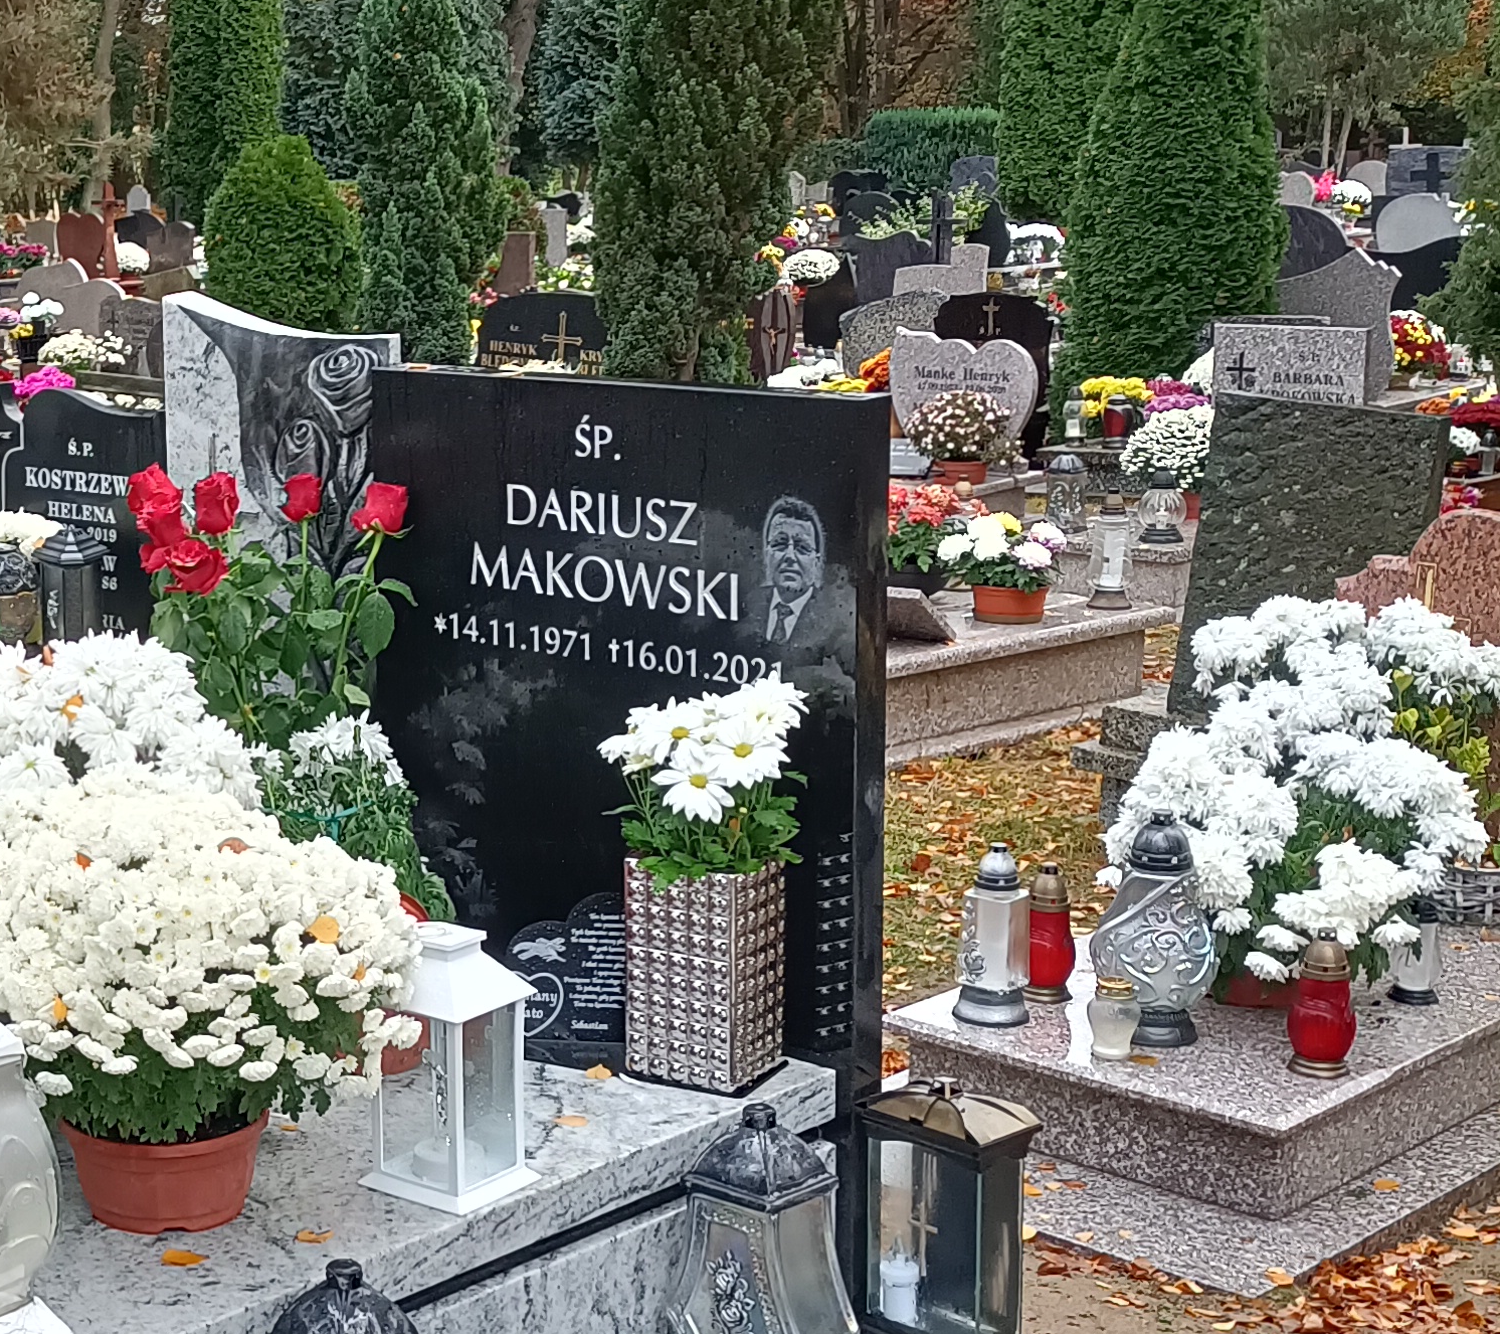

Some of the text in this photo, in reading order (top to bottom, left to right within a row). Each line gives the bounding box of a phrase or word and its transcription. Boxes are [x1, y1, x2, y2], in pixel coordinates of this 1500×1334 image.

[489, 340, 537, 356] HENRYK
[963, 367, 1011, 384] Henryk
[1272, 371, 1345, 387] BARBARA
[67, 437, 95, 458] Ś.P.
[25, 466, 132, 497] KOSTRZEW
[47, 500, 117, 525] HELENA
[505, 483, 698, 546] DARIUSZ
[470, 541, 740, 622] MAKOWSKI
